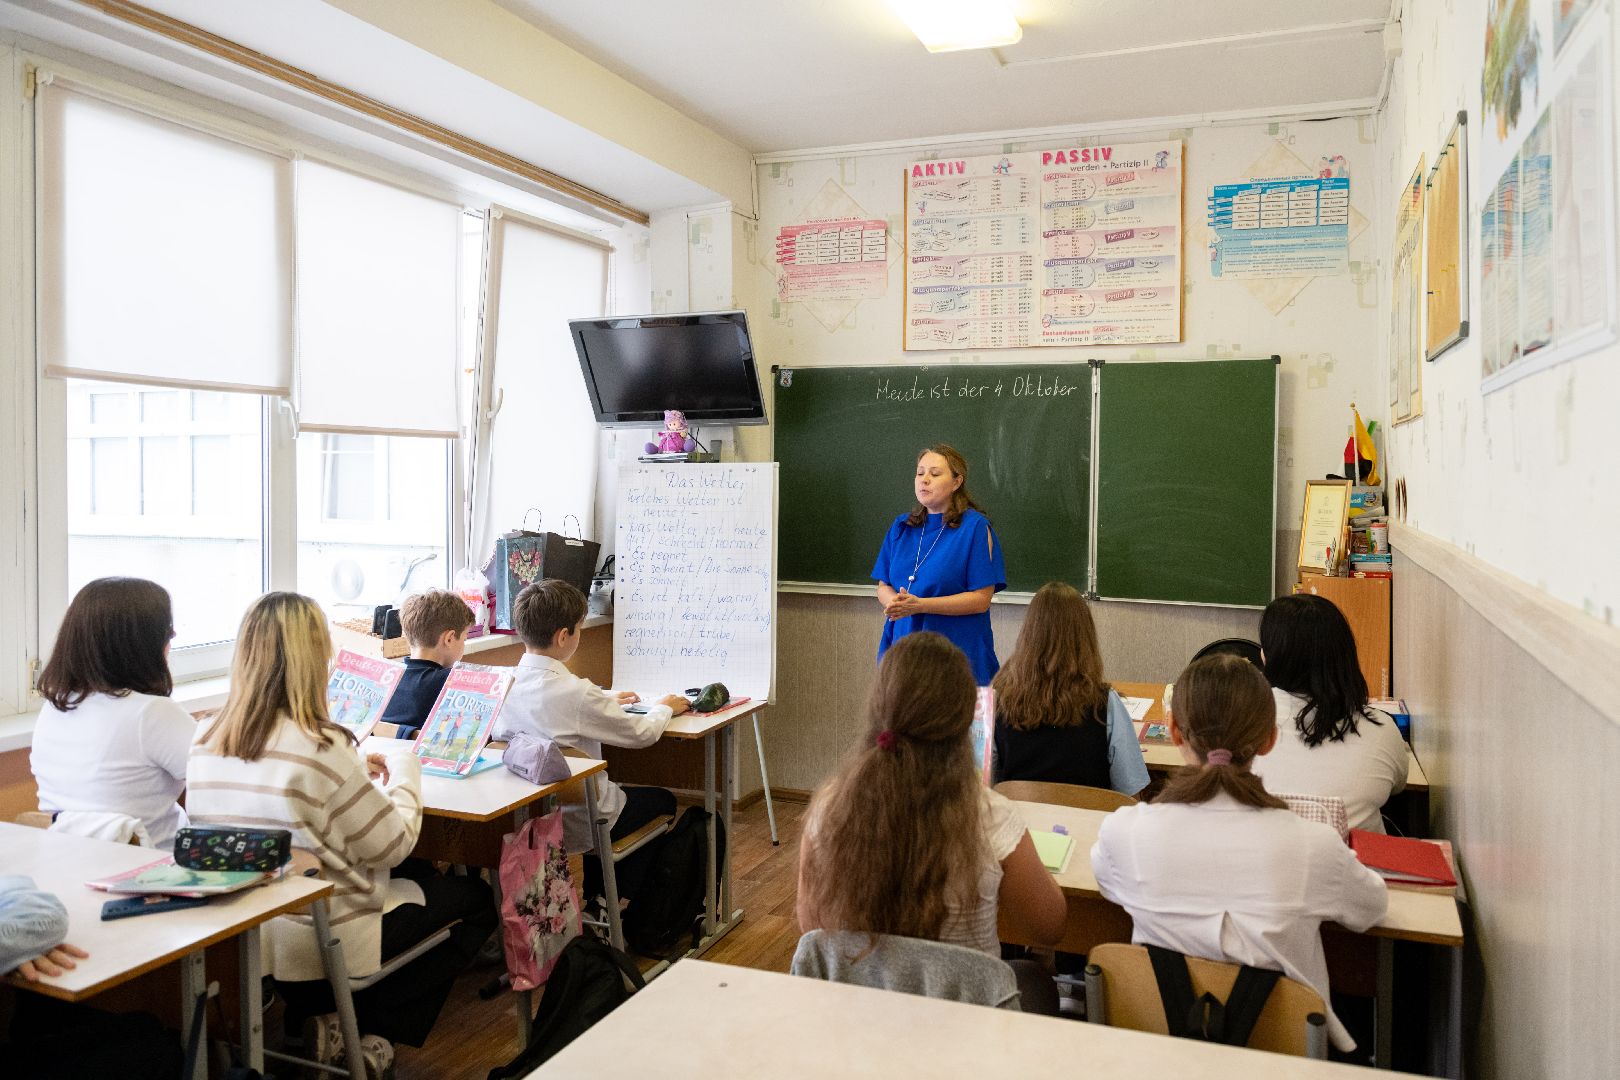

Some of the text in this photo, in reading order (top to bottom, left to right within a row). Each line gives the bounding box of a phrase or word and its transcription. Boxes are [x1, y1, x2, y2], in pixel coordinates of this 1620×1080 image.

[1042, 147, 1113, 166] PASSIV
[911, 160, 966, 178] AKTIV
[1070, 163, 1100, 172] werden
[1110, 160, 1141, 169] Partizip
[930, 376, 951, 399] ist
[958, 378, 990, 398] der
[1013, 372, 1079, 398] Oktober
[342, 653, 383, 673] Deutsch
[380, 666, 398, 685] 6
[453, 670, 493, 685] Deutsch
